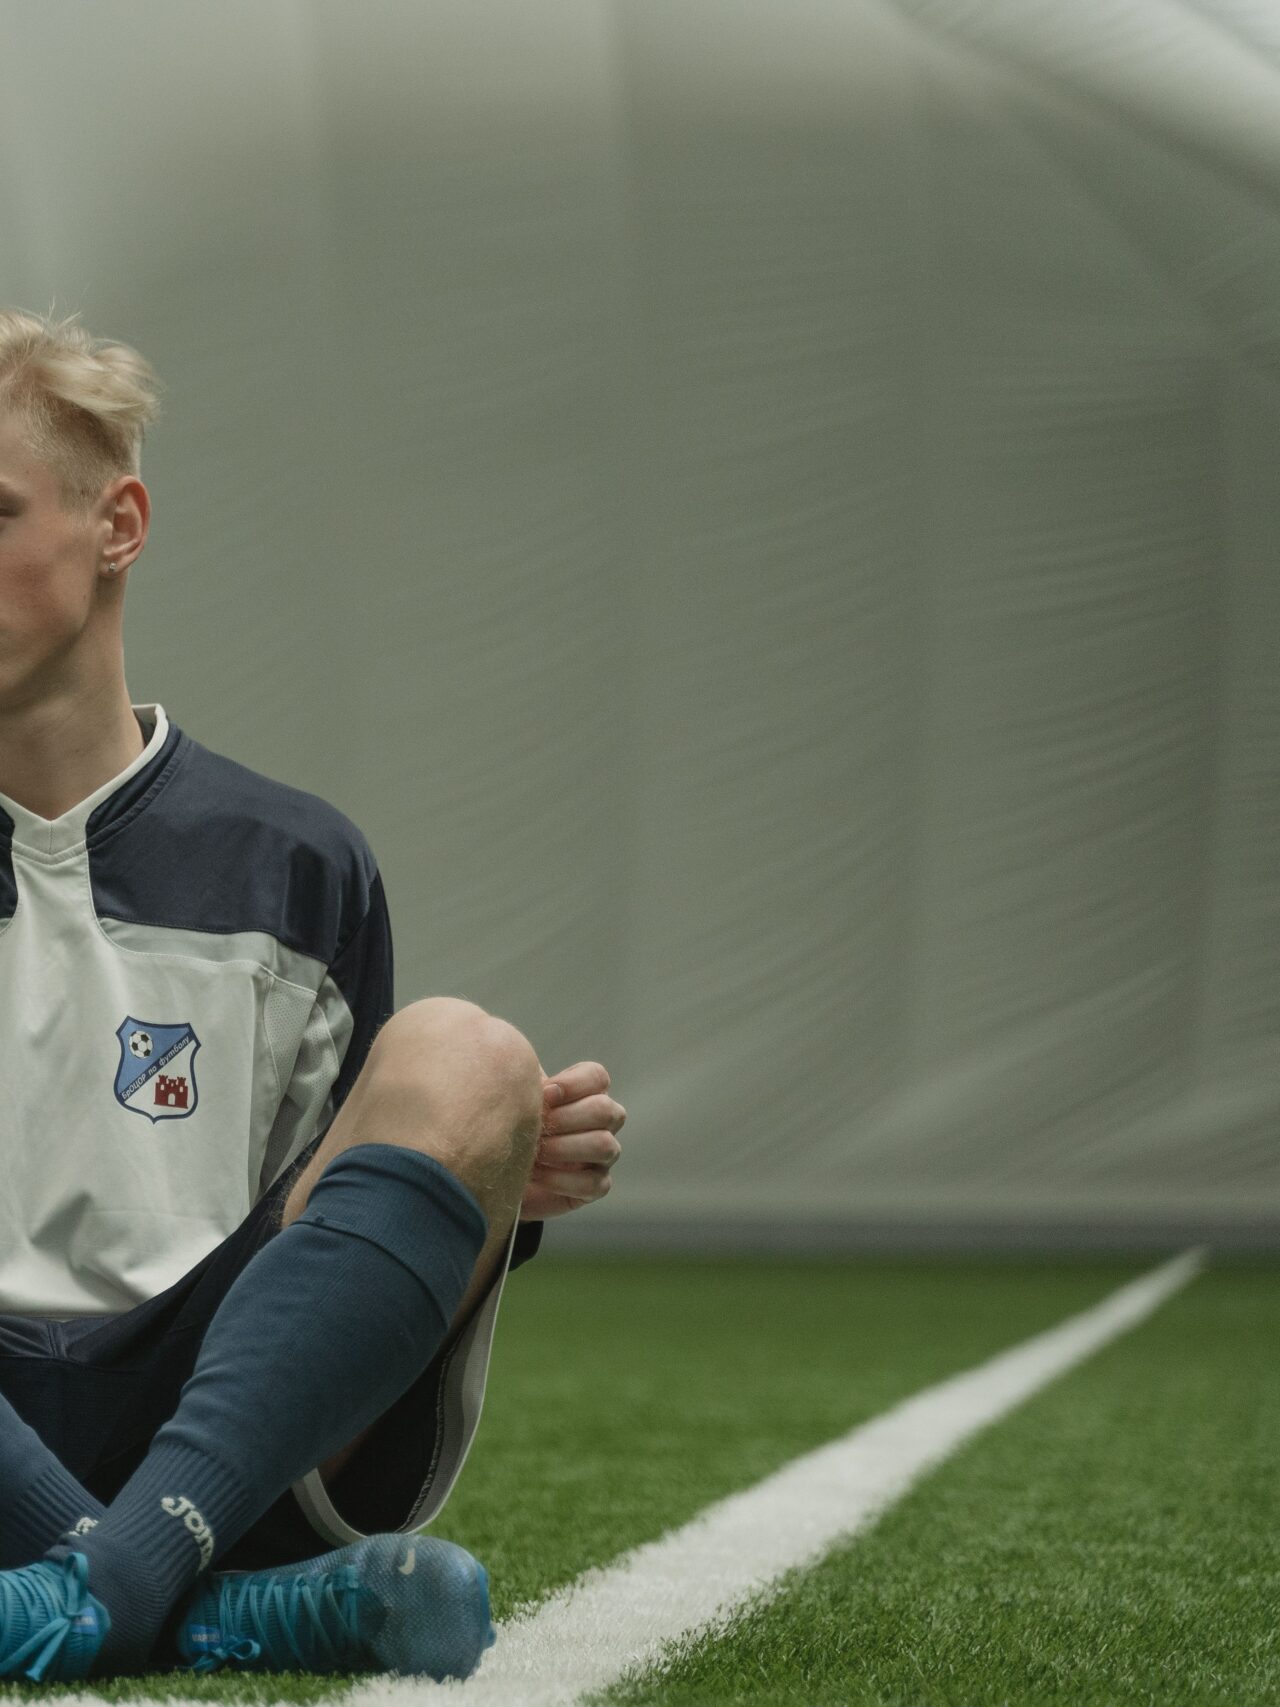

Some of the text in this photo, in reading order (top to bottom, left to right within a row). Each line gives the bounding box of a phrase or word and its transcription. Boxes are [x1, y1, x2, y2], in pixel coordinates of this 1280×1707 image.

[148, 1066, 157, 1077] по
[158, 1036, 190, 1068] футболу
[160, 1496, 215, 1573] Jom
